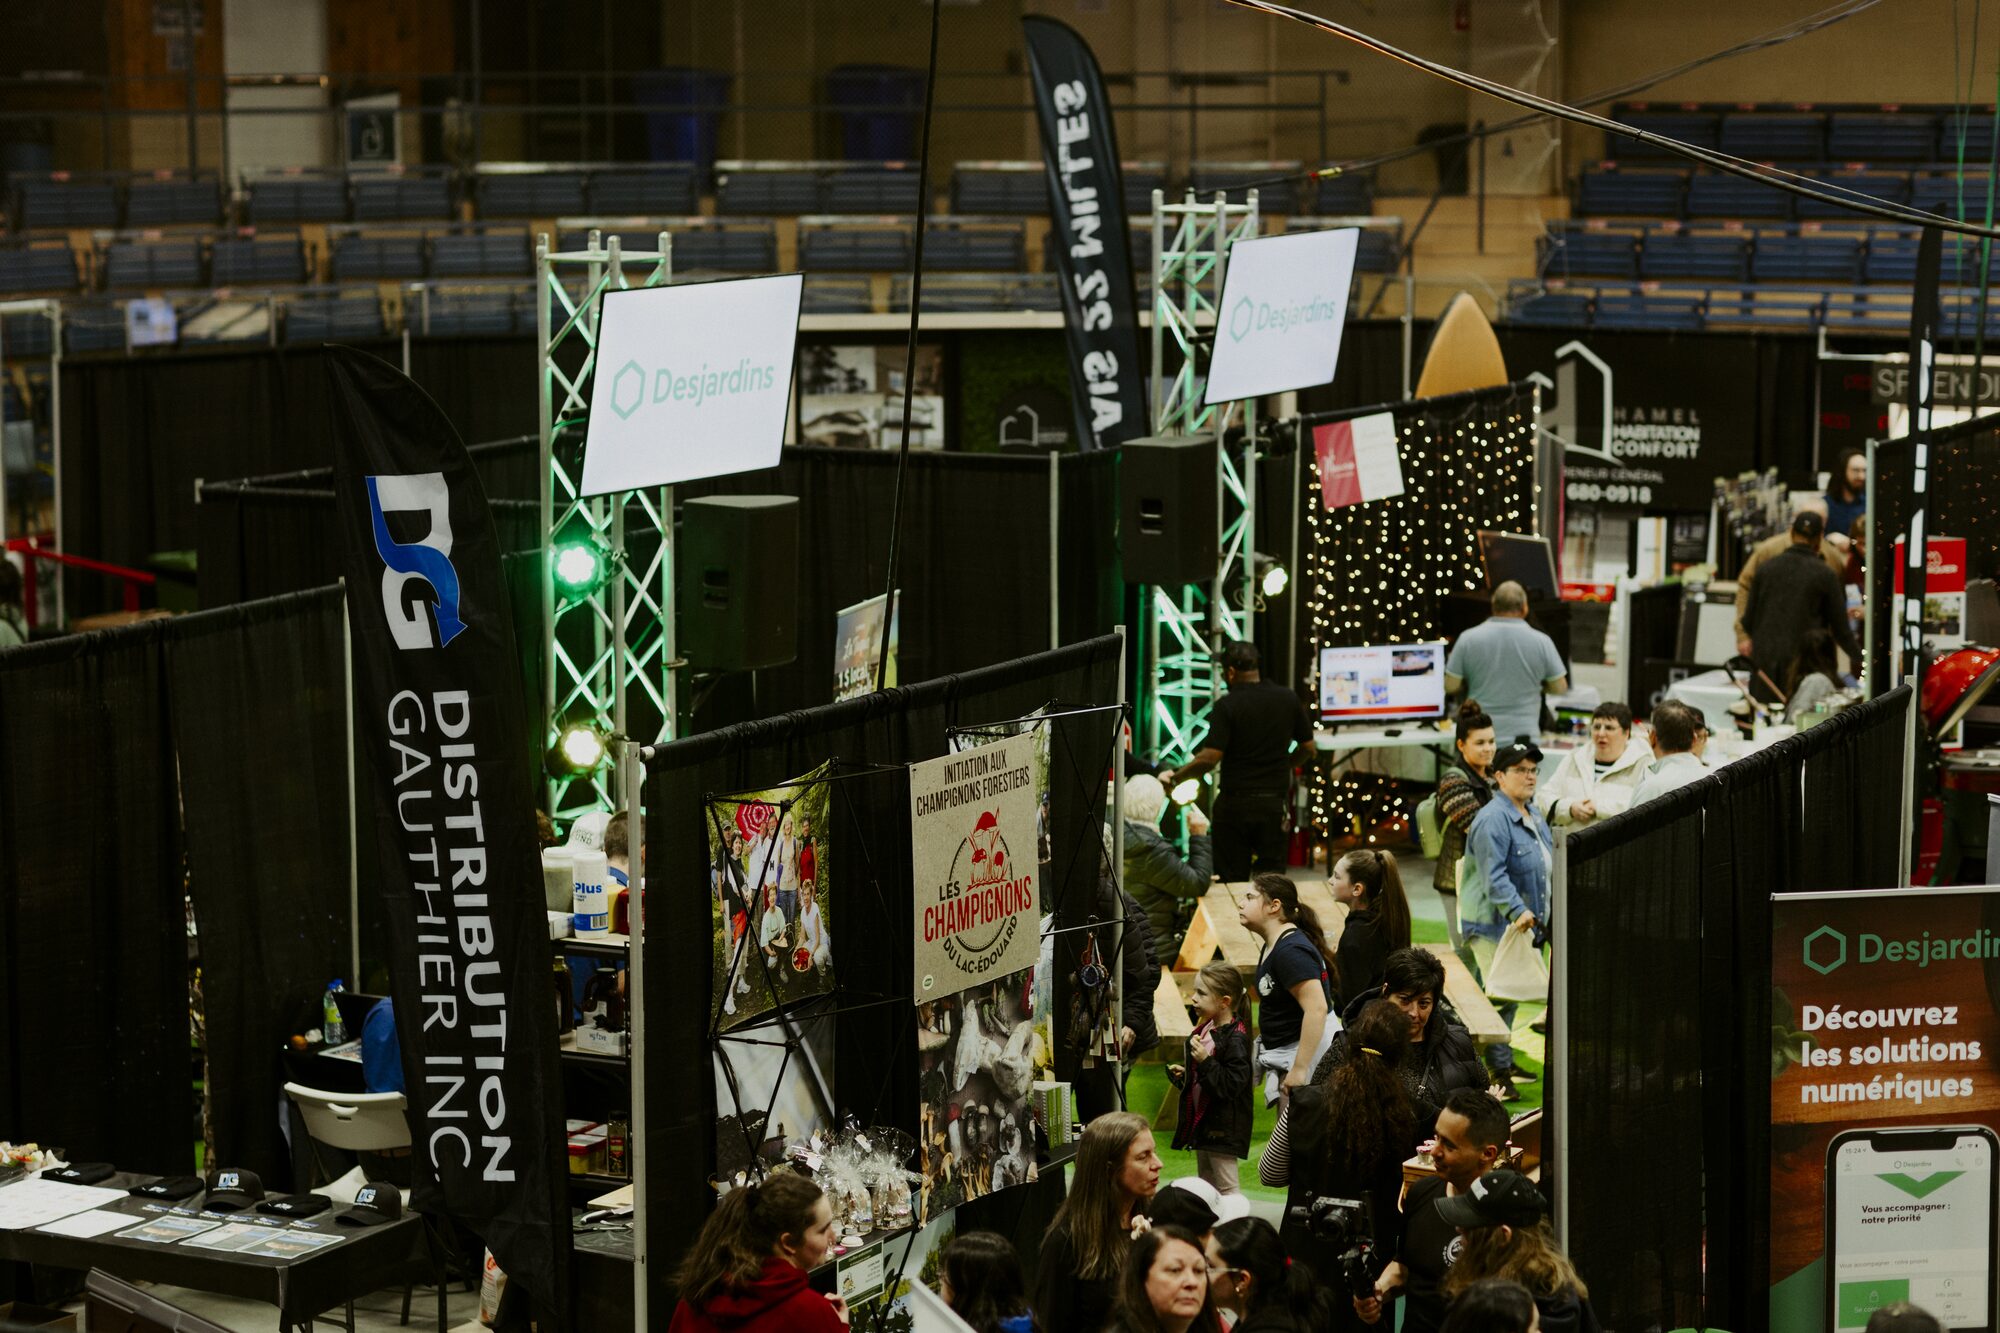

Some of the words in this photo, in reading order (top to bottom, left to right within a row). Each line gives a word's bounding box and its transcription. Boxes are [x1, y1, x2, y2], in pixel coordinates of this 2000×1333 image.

[1256, 294, 1336, 333] Desjardins
[652, 358, 775, 407] Desjardins
[1614, 406, 1700, 424] HAMEL
[1613, 424, 1701, 441] HABITATION
[1612, 440, 1700, 459] CONFORT
[1566, 482, 1652, 504] 680-0918
[944, 754, 988, 785] INITIATION
[990, 749, 1008, 773] AUX
[916, 780, 981, 817] CHAMPIGNONS
[983, 765, 1030, 798] FORESTIERS
[575, 882, 603, 894] Plus
[939, 880, 960, 901] LES
[924, 875, 1032, 943] CHAMPIGNONS
[388, 690, 458, 1032] GAUTHIER
[424, 1056, 472, 1182] INC.
[433, 690, 516, 1182] DISTRIBUTION
[943, 937, 957, 960] DU
[955, 915, 1018, 974] LAC-ÉDOUARD
[1802, 1004, 1958, 1031] Découvrez
[1801, 1041, 1842, 1067] les
[1849, 1034, 1981, 1065] solutions
[1801, 1072, 1974, 1105] numériques
[1861, 1215, 1885, 1224] notre
[1887, 1213, 1921, 1225] priorité
[1862, 1204, 1883, 1213] Vous
[1884, 1203, 1945, 1213] accompagner
